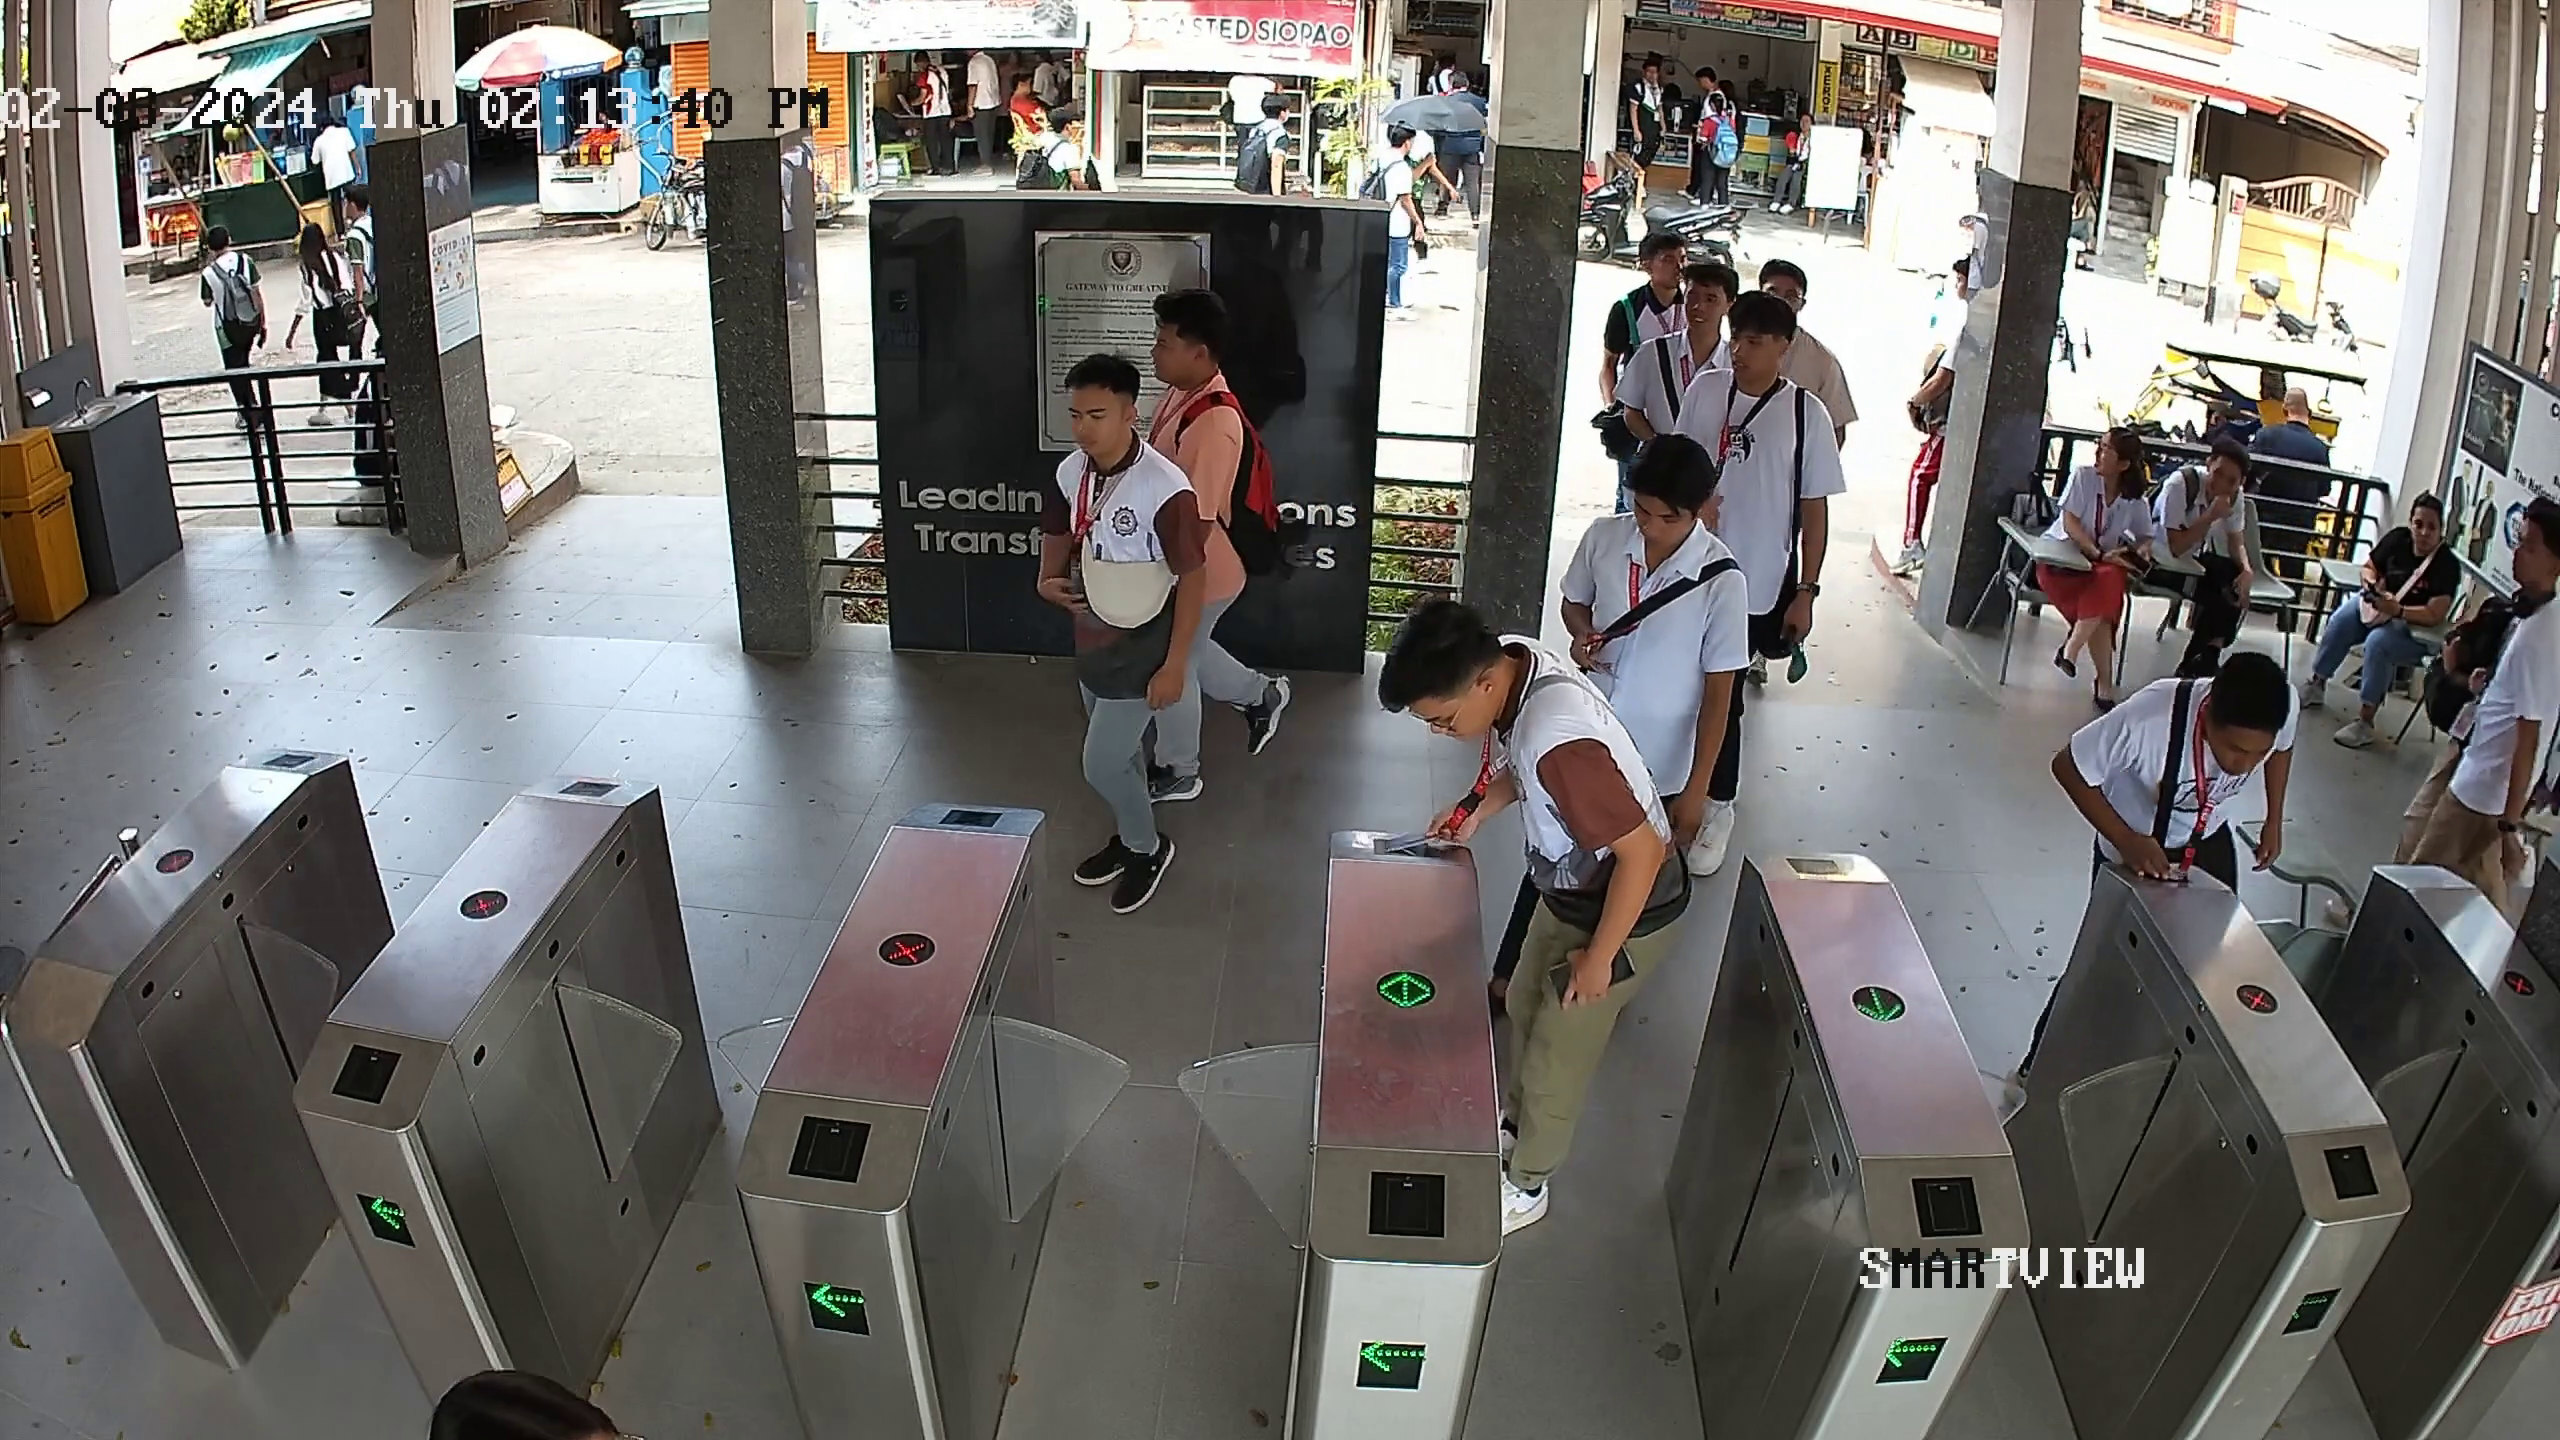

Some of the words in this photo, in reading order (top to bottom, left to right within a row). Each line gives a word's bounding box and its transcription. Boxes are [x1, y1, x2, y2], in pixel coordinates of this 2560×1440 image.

[1141, 17, 1250, 40] ASTED
[1256, 19, 1350, 47] SIOPAO
[1065, 283, 1109, 293] GATEWAY
[1112, 284, 1125, 293] TO
[1126, 284, 1169, 294] GREATNE
[899, 481, 1043, 513] Leadin
[914, 523, 1043, 556] Transf
